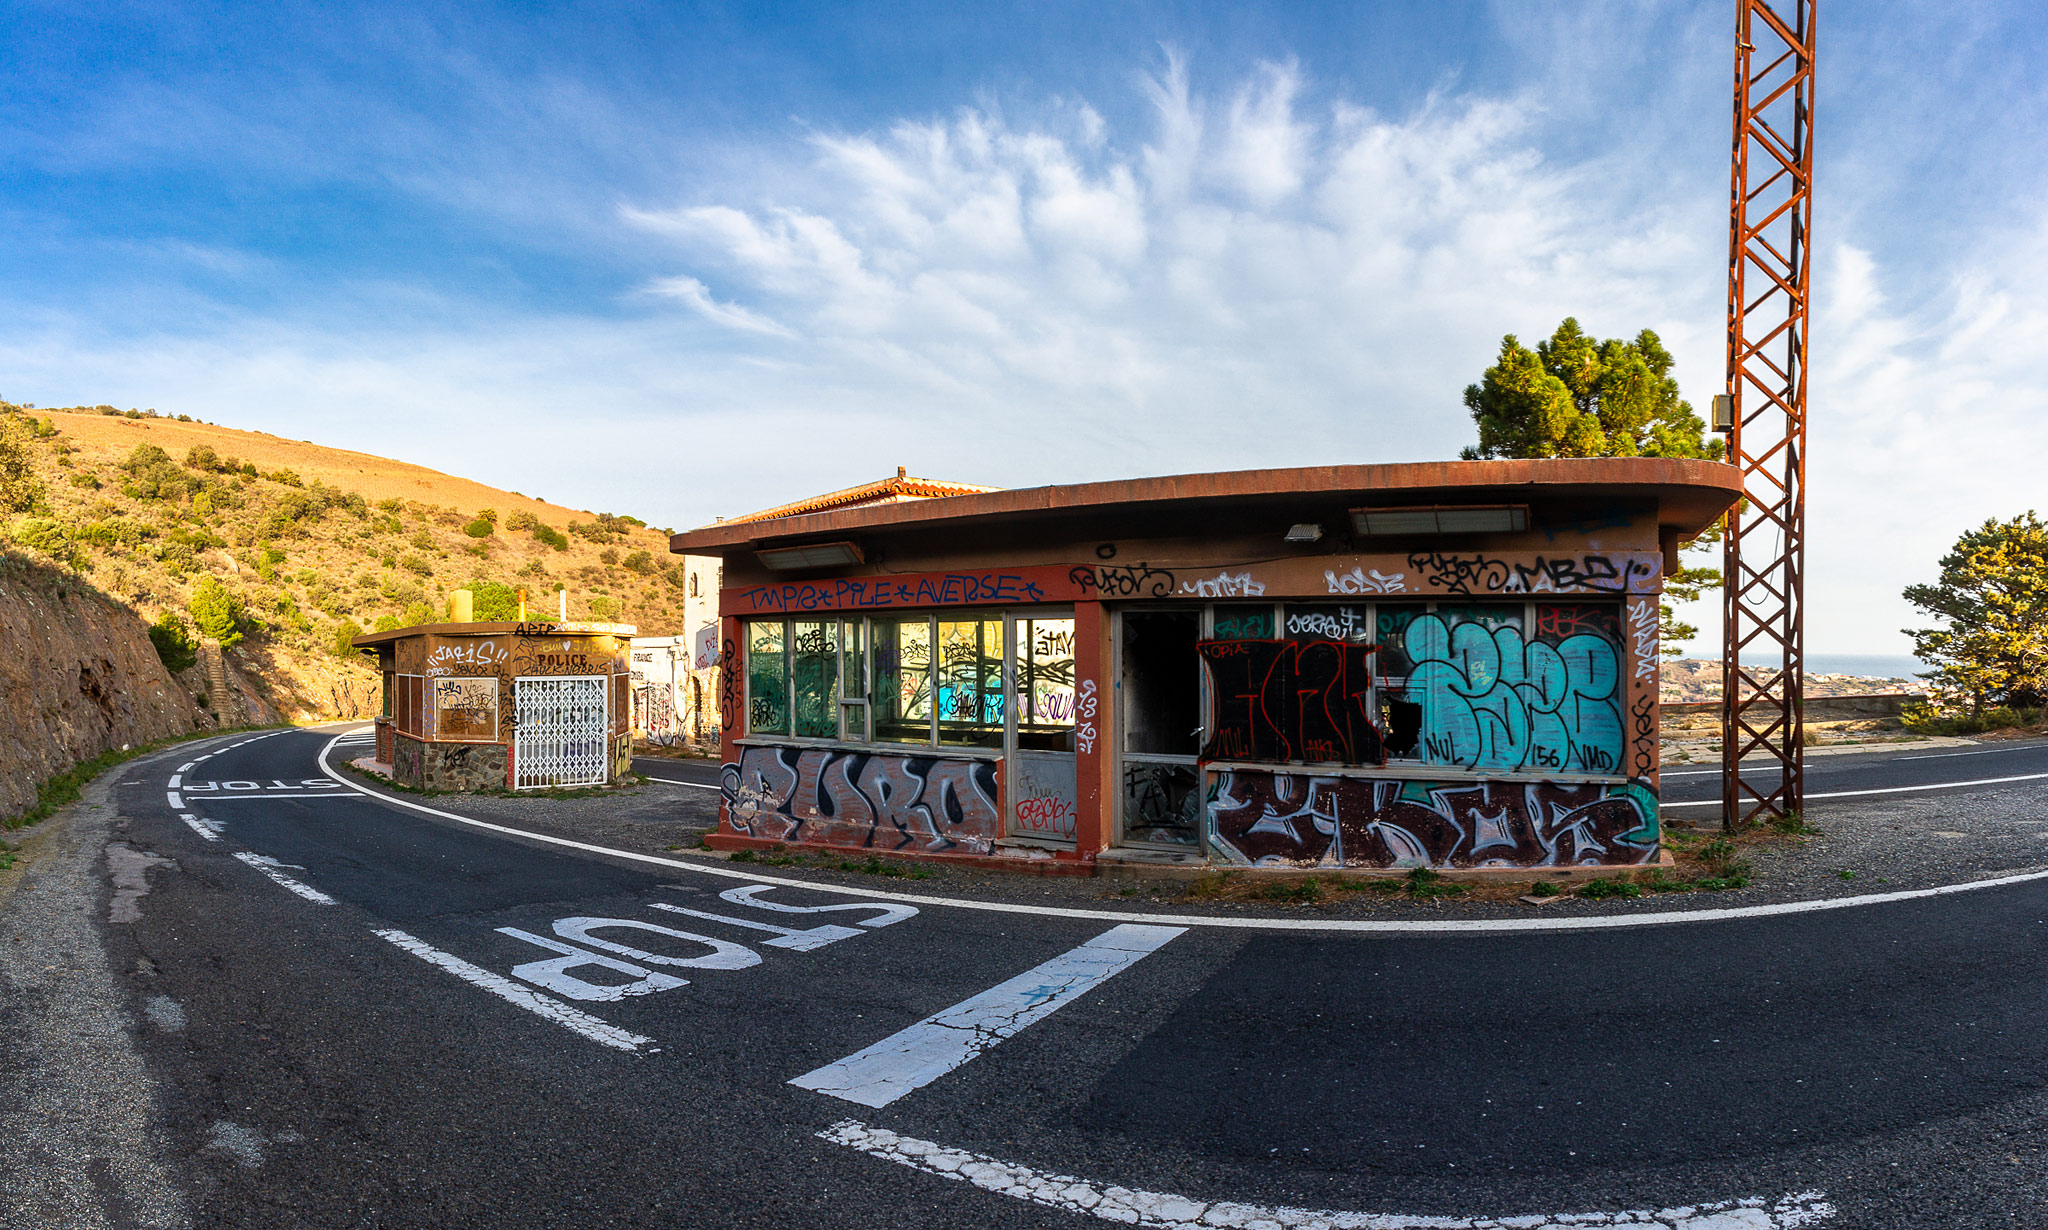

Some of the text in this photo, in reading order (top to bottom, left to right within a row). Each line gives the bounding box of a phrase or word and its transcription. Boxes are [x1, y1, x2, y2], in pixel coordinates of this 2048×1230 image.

[538, 654, 588, 666] POLICE
[1425, 731, 1464, 764] NUL
[1532, 743, 1560, 768] 156
[183, 779, 341, 791] STOP
[494, 884, 920, 1001] STOP
